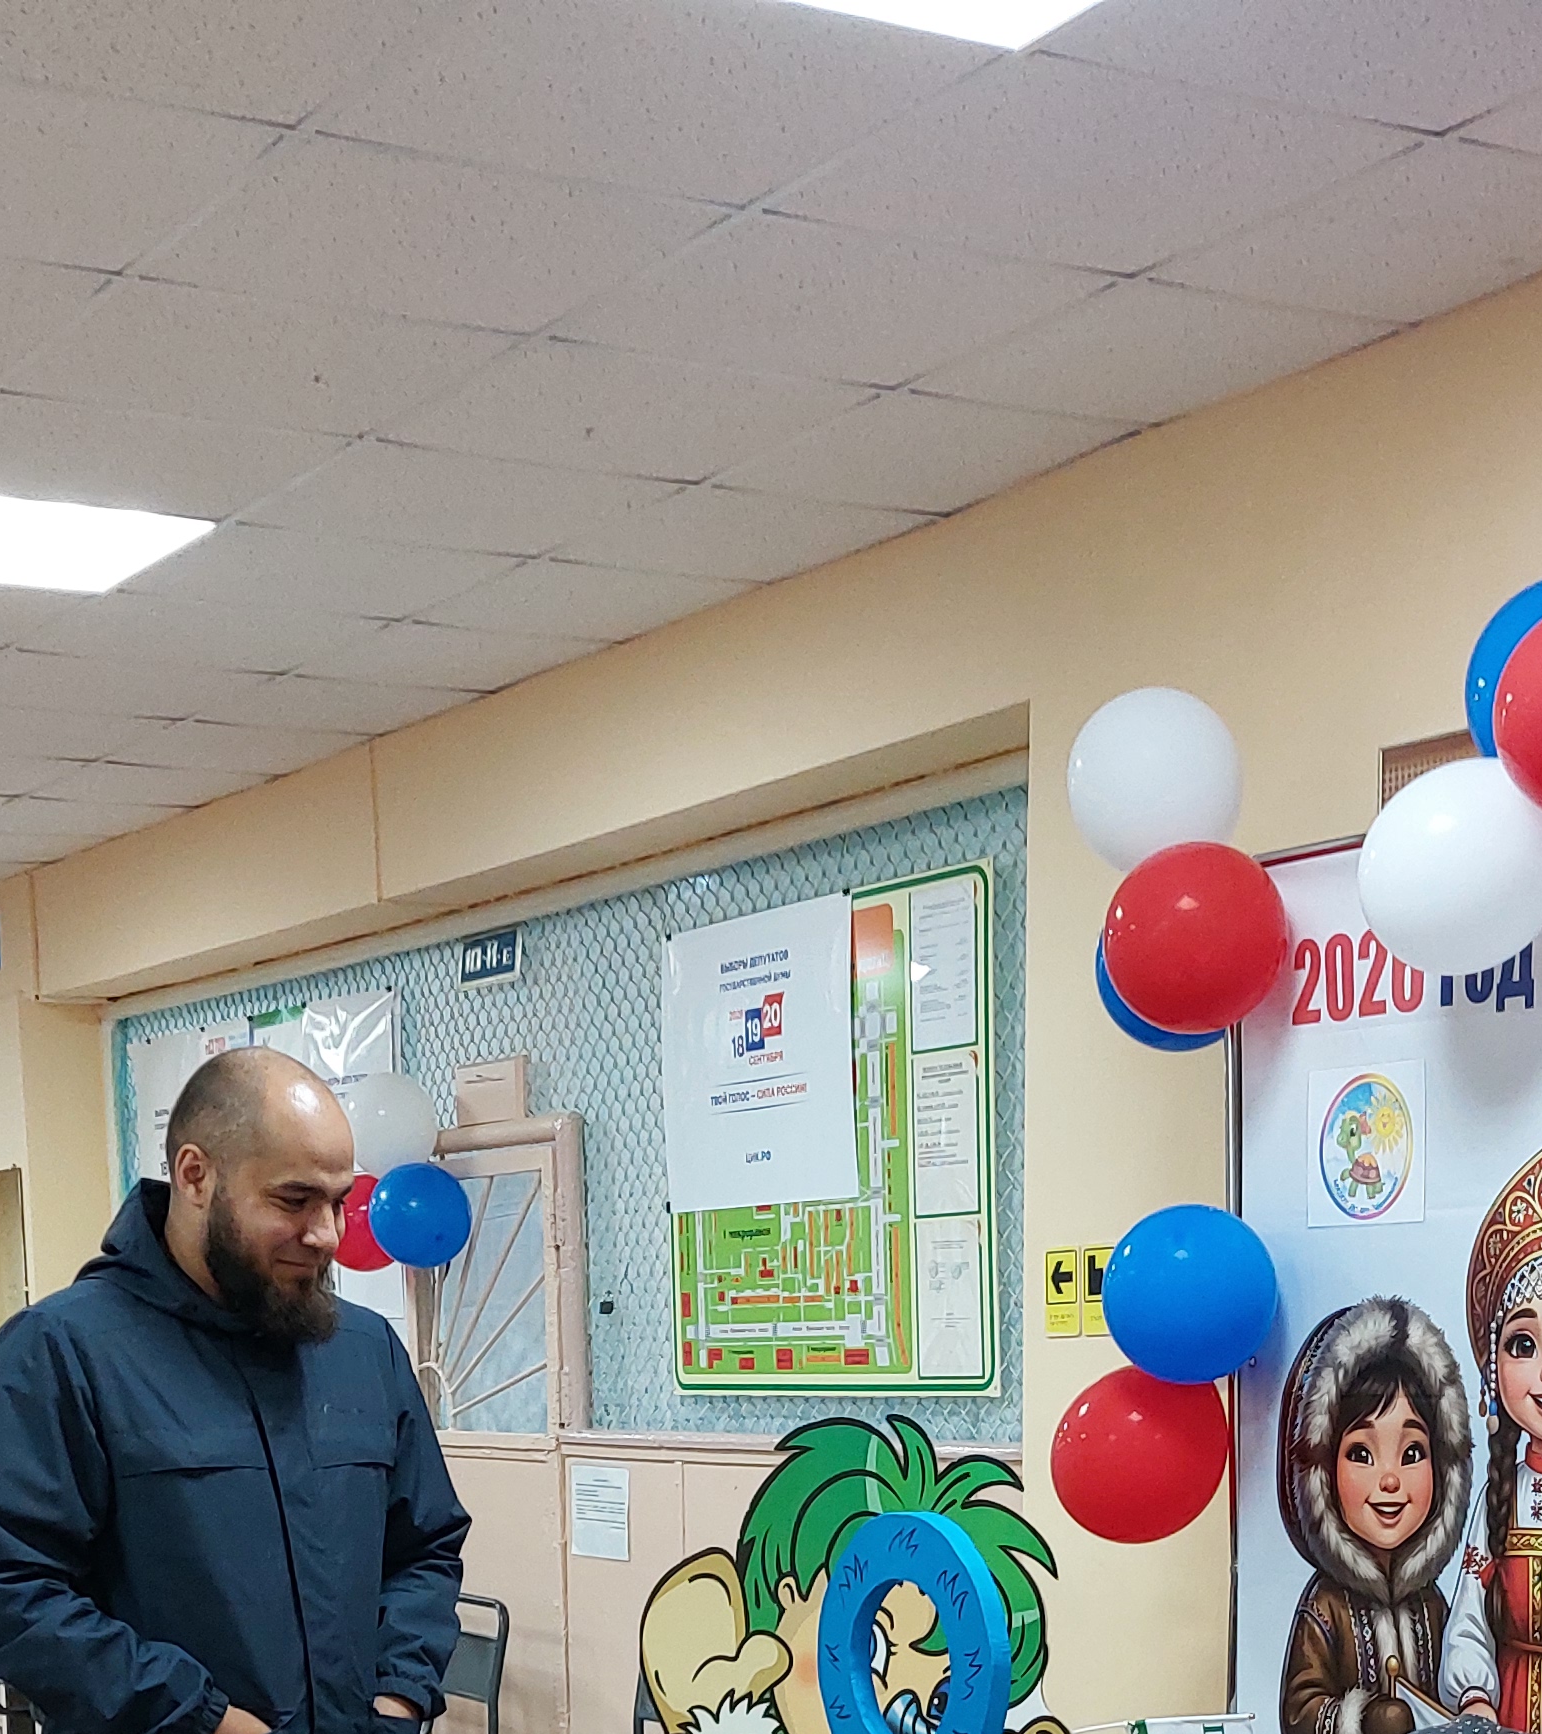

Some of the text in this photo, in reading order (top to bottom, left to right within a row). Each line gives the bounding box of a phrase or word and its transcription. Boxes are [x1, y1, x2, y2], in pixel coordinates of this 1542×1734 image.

[762, 1002, 780, 1029] 20
[746, 1018, 761, 1043] 19
[731, 1035, 745, 1059] 18
